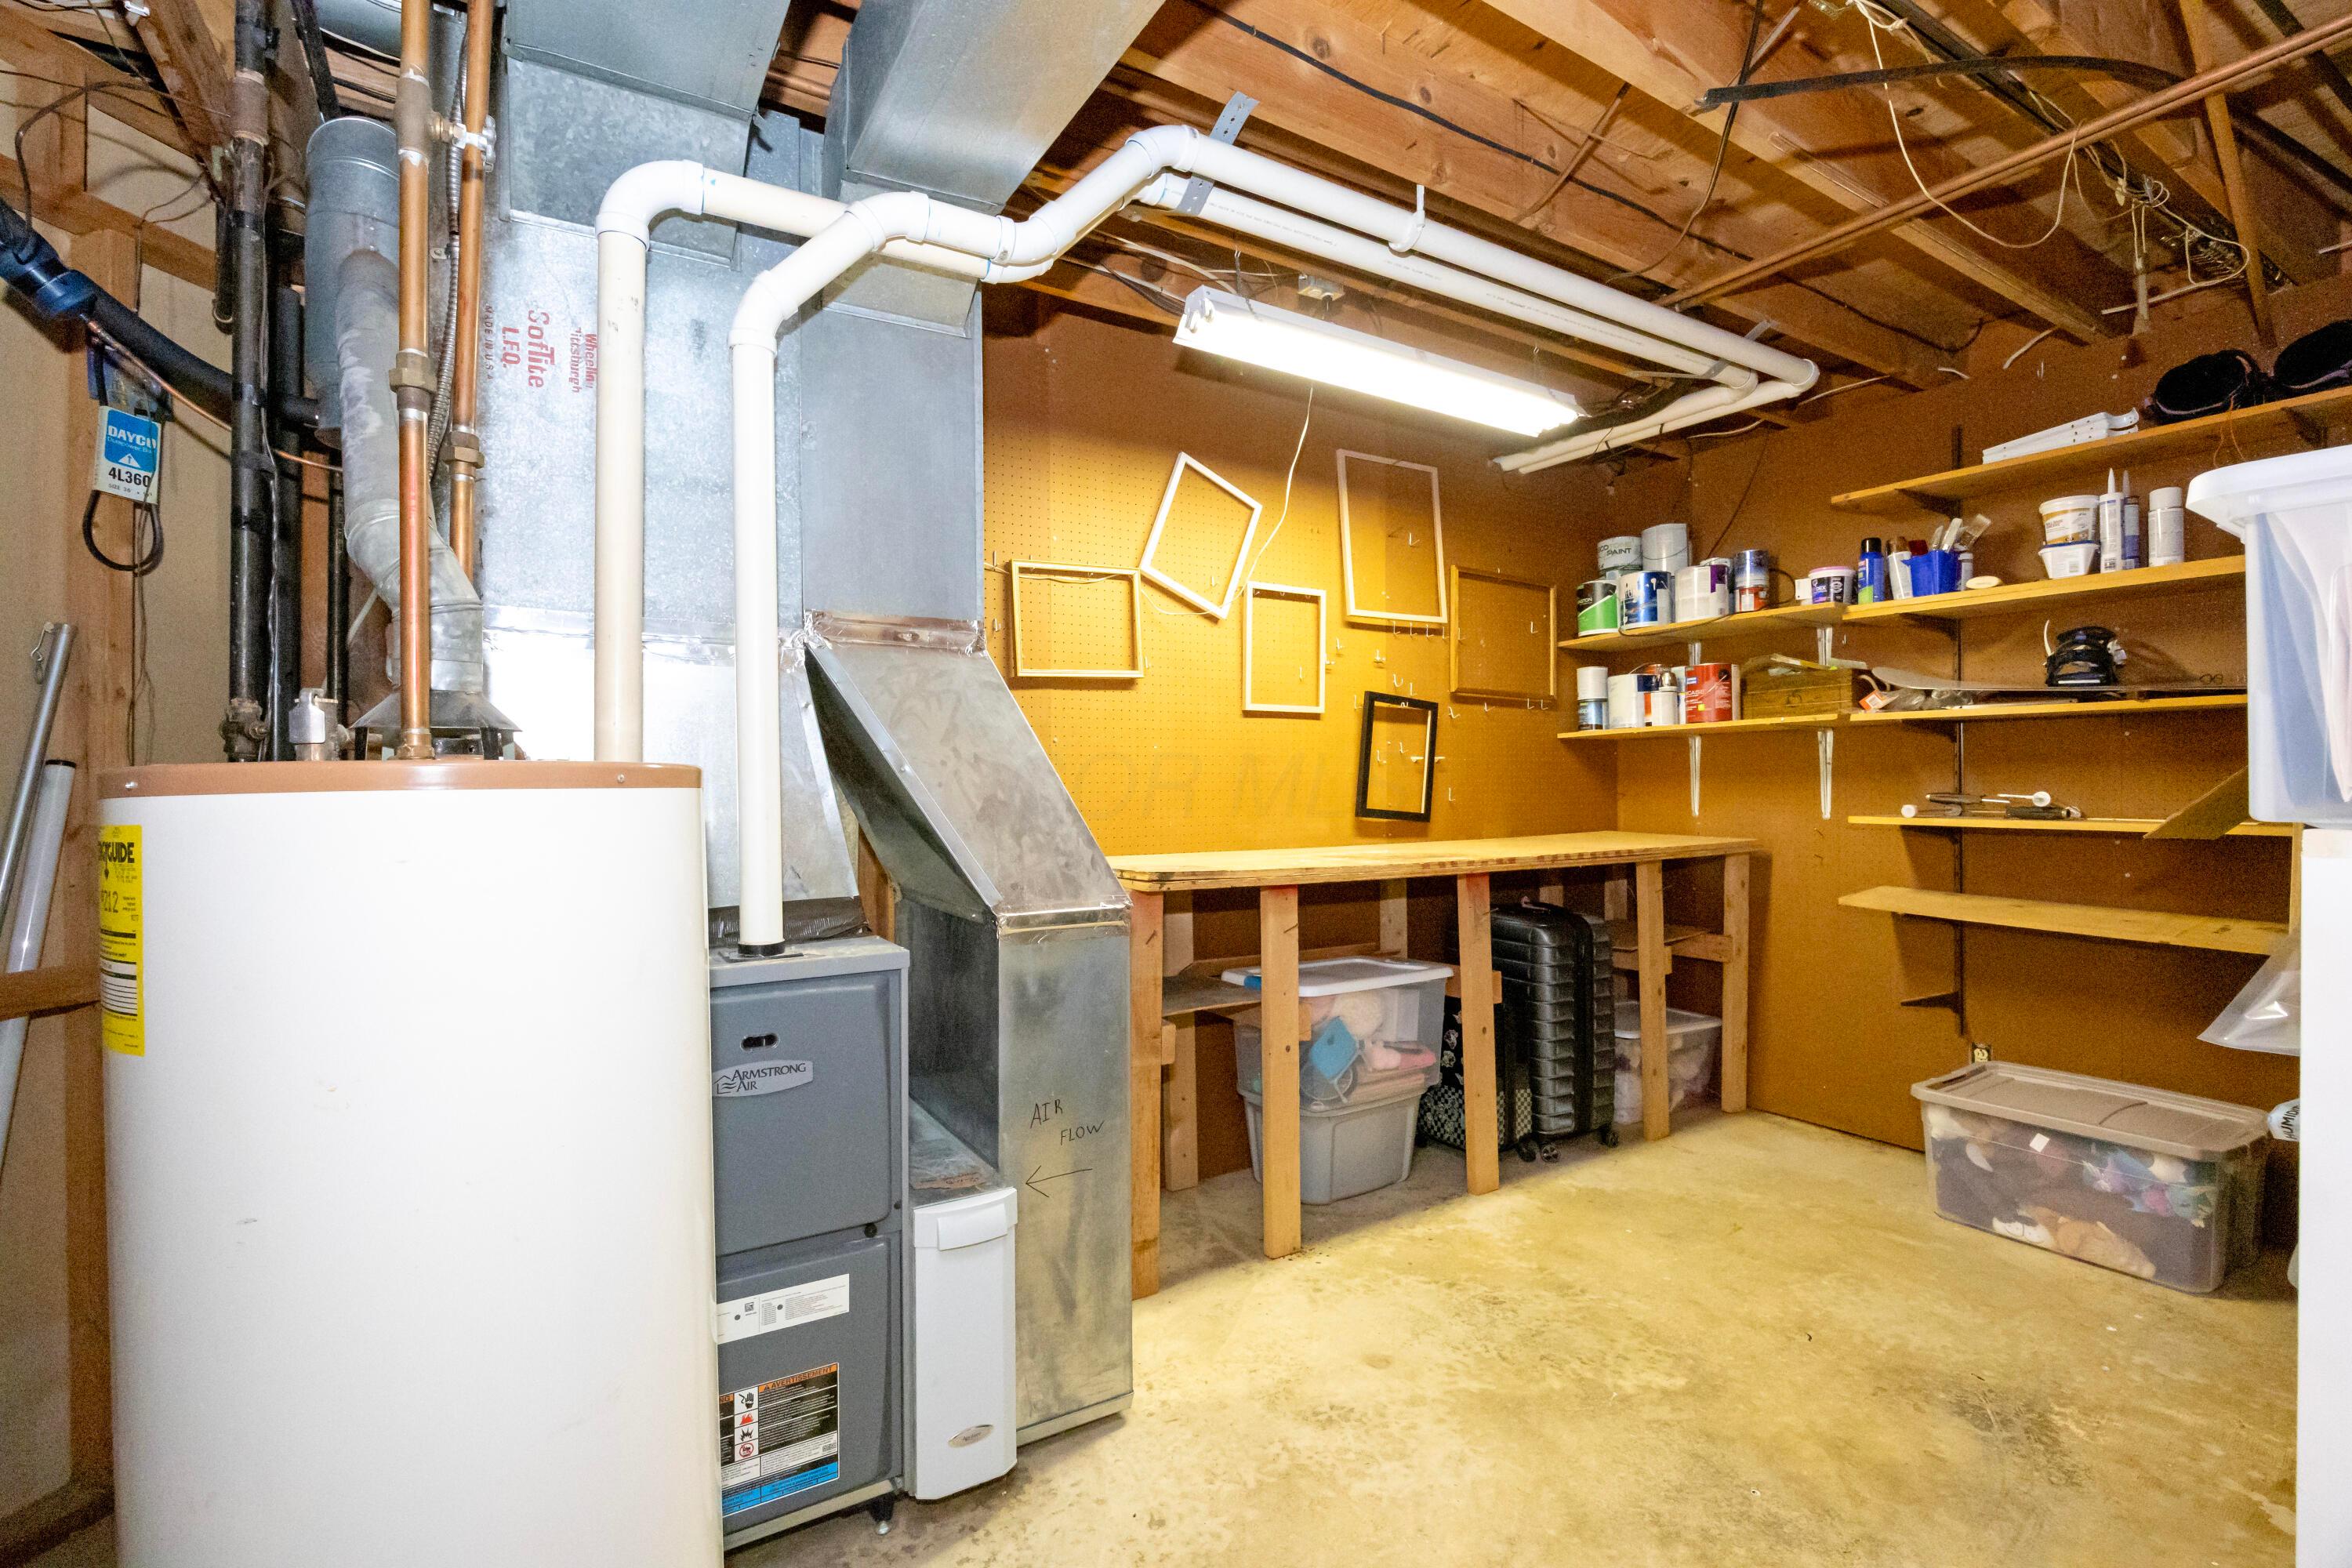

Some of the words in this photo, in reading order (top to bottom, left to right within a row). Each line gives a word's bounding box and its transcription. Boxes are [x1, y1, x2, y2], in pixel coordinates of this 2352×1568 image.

[107, 425, 157, 450] DAYCO
[108, 466, 151, 488] 4L360
[1606, 547, 1632, 556] PAINT
[731, 1062, 807, 1081] ARMSTRONG
[736, 1080, 758, 1092] AIR
[1030, 1098, 1063, 1129] AIR
[1060, 1120, 1105, 1146] FLOW
[771, 1366, 832, 1390] AVERTISSEMENT
